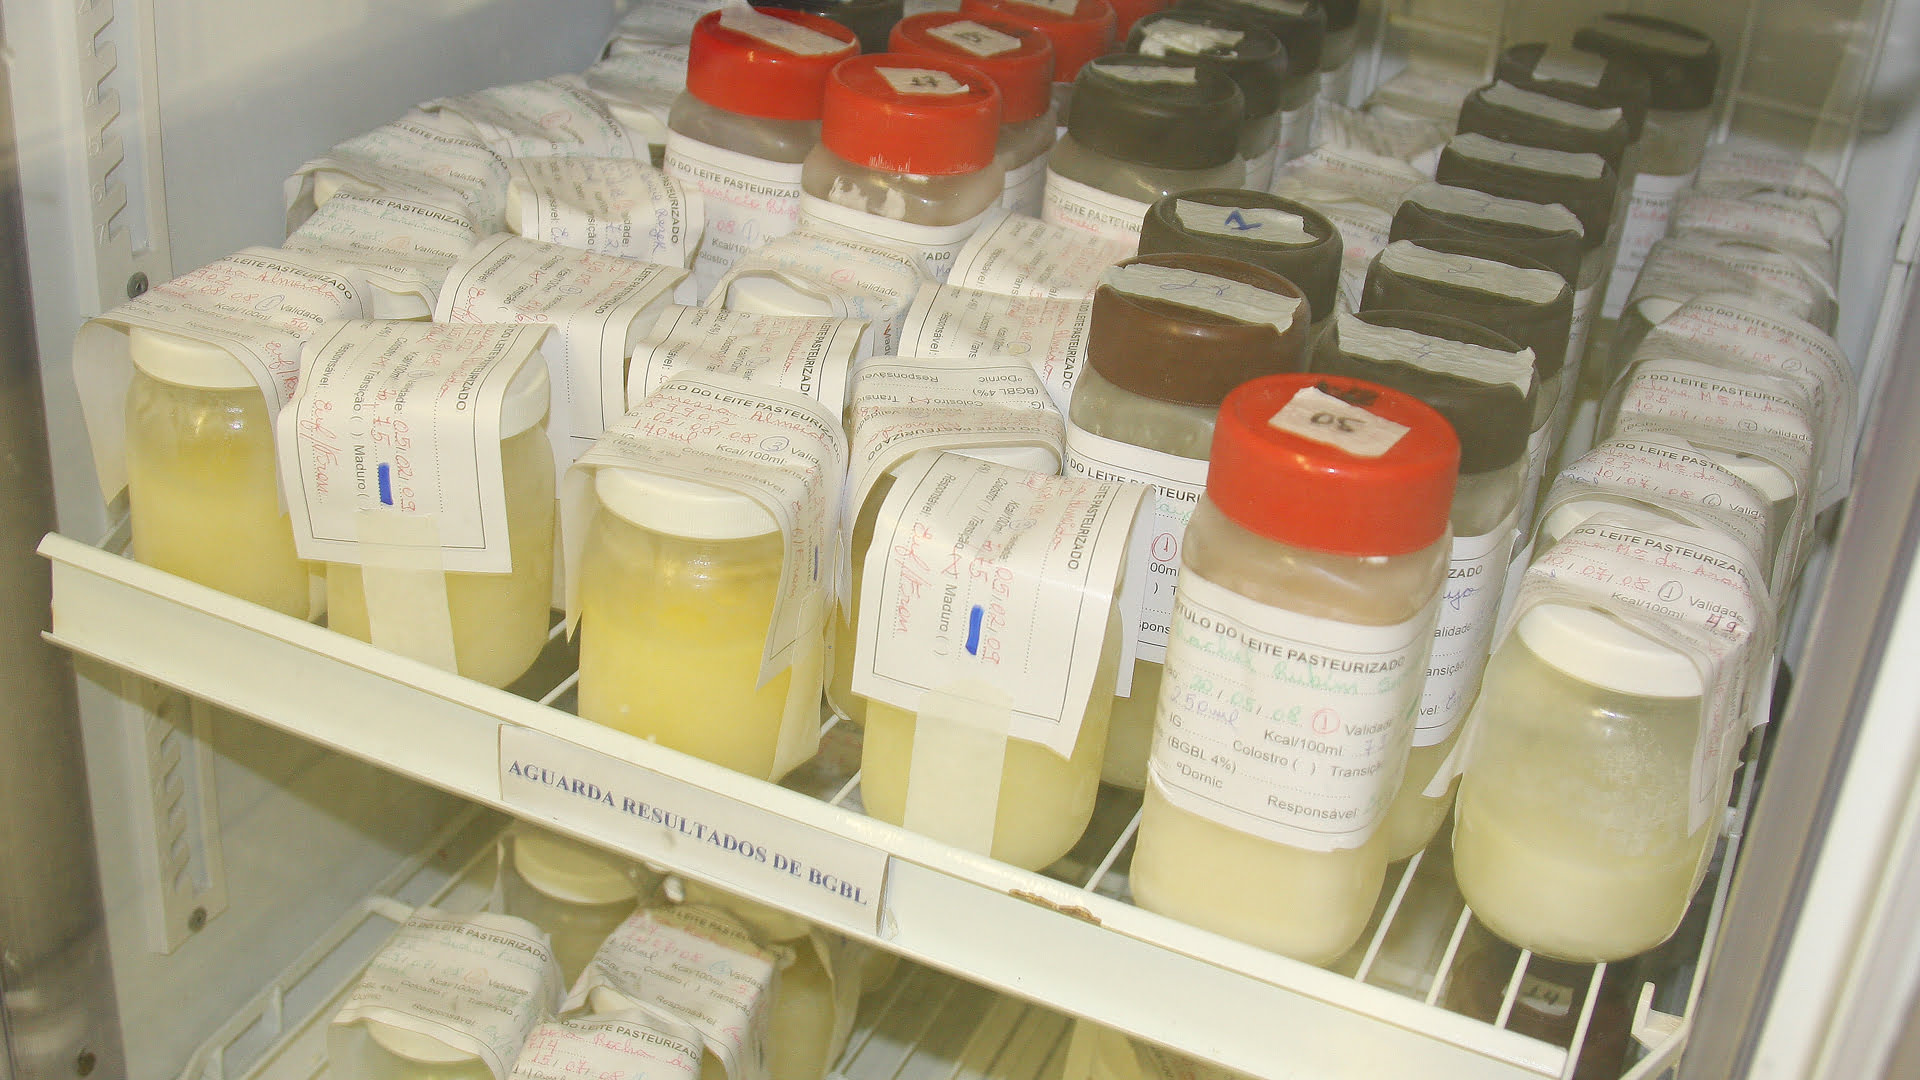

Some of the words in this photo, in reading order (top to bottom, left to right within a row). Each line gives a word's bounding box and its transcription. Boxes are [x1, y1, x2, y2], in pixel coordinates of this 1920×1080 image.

[693, 165, 722, 182] LEITE
[724, 176, 800, 198] PASTEURIZAD
[233, 258, 266, 269] LEITE
[267, 262, 353, 300] PASTEURIZADO
[800, 336, 825, 396] PASTEURIZAD
[1650, 374, 1669, 382] DO
[1673, 376, 1708, 389] LEITE
[690, 388, 711, 397] DO
[714, 393, 753, 408] LEITE
[756, 402, 841, 464] PASTEURIZADO
[354, 444, 369, 490] Maduro
[1069, 458, 1085, 473] DO
[1639, 446, 1678, 460] LEITE
[1067, 500, 1103, 570] PASTEURIZADO
[1599, 530, 1642, 544] LEITE
[939, 583, 958, 633] Maduro
[1690, 595, 1744, 623] Validade
[1215, 624, 1238, 639] DO
[1240, 634, 1283, 658] LEITE
[1287, 649, 1406, 674] PASTEURIZADO
[1426, 660, 1467, 677] ansição
[1167, 735, 1206, 761] (BGBL
[1211, 754, 1237, 774] 4%)
[1232, 740, 1289, 767] Colostro
[509, 760, 615, 808] AGUARDA
[622, 795, 767, 864] RESULTADOS
[773, 853, 802, 877] DE
[809, 867, 868, 906] BGBL
[466, 928, 549, 963] PASTEURIZADO
